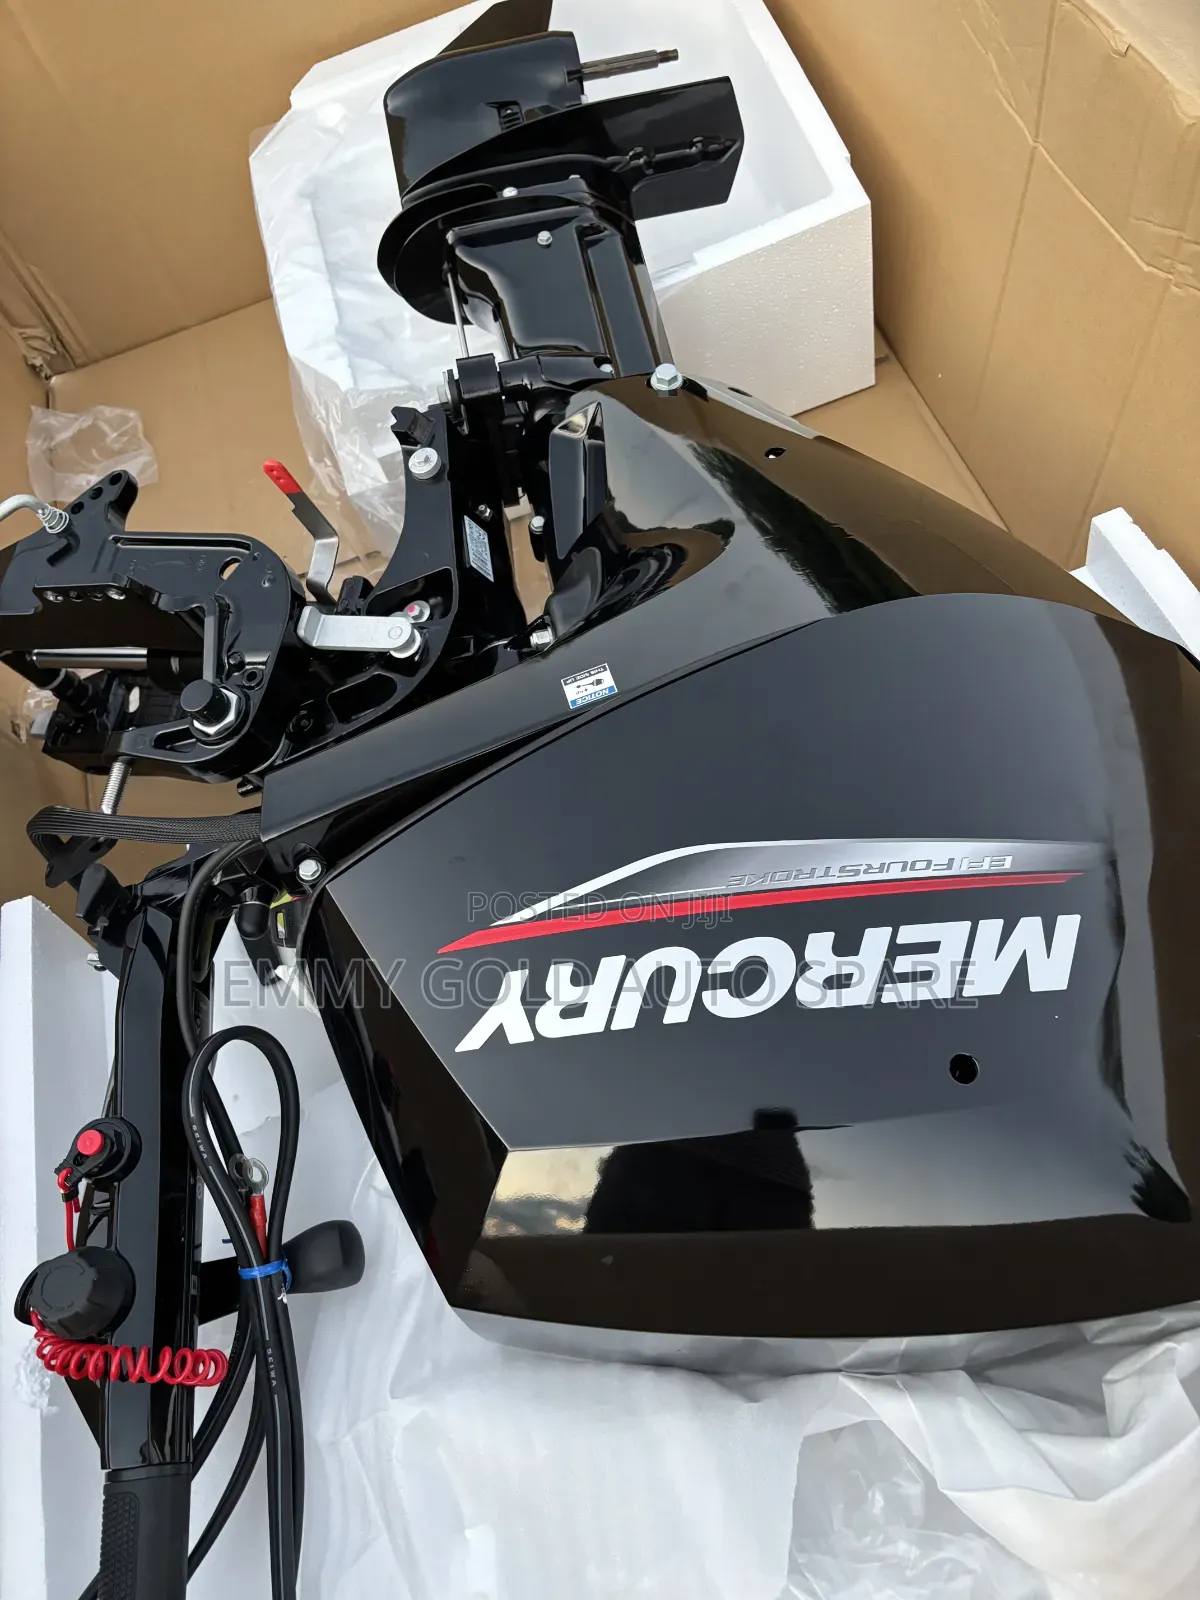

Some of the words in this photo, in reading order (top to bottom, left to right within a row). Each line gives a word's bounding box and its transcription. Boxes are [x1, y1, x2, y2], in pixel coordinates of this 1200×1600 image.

[575, 672, 590, 680] SIDE
[590, 667, 604, 675] THIS
[576, 689, 609, 704] NOTICE
[959, 855, 1013, 870] EFI
[728, 858, 955, 888] FOURSTROKE
[454, 914, 1082, 1053] MERCURY
